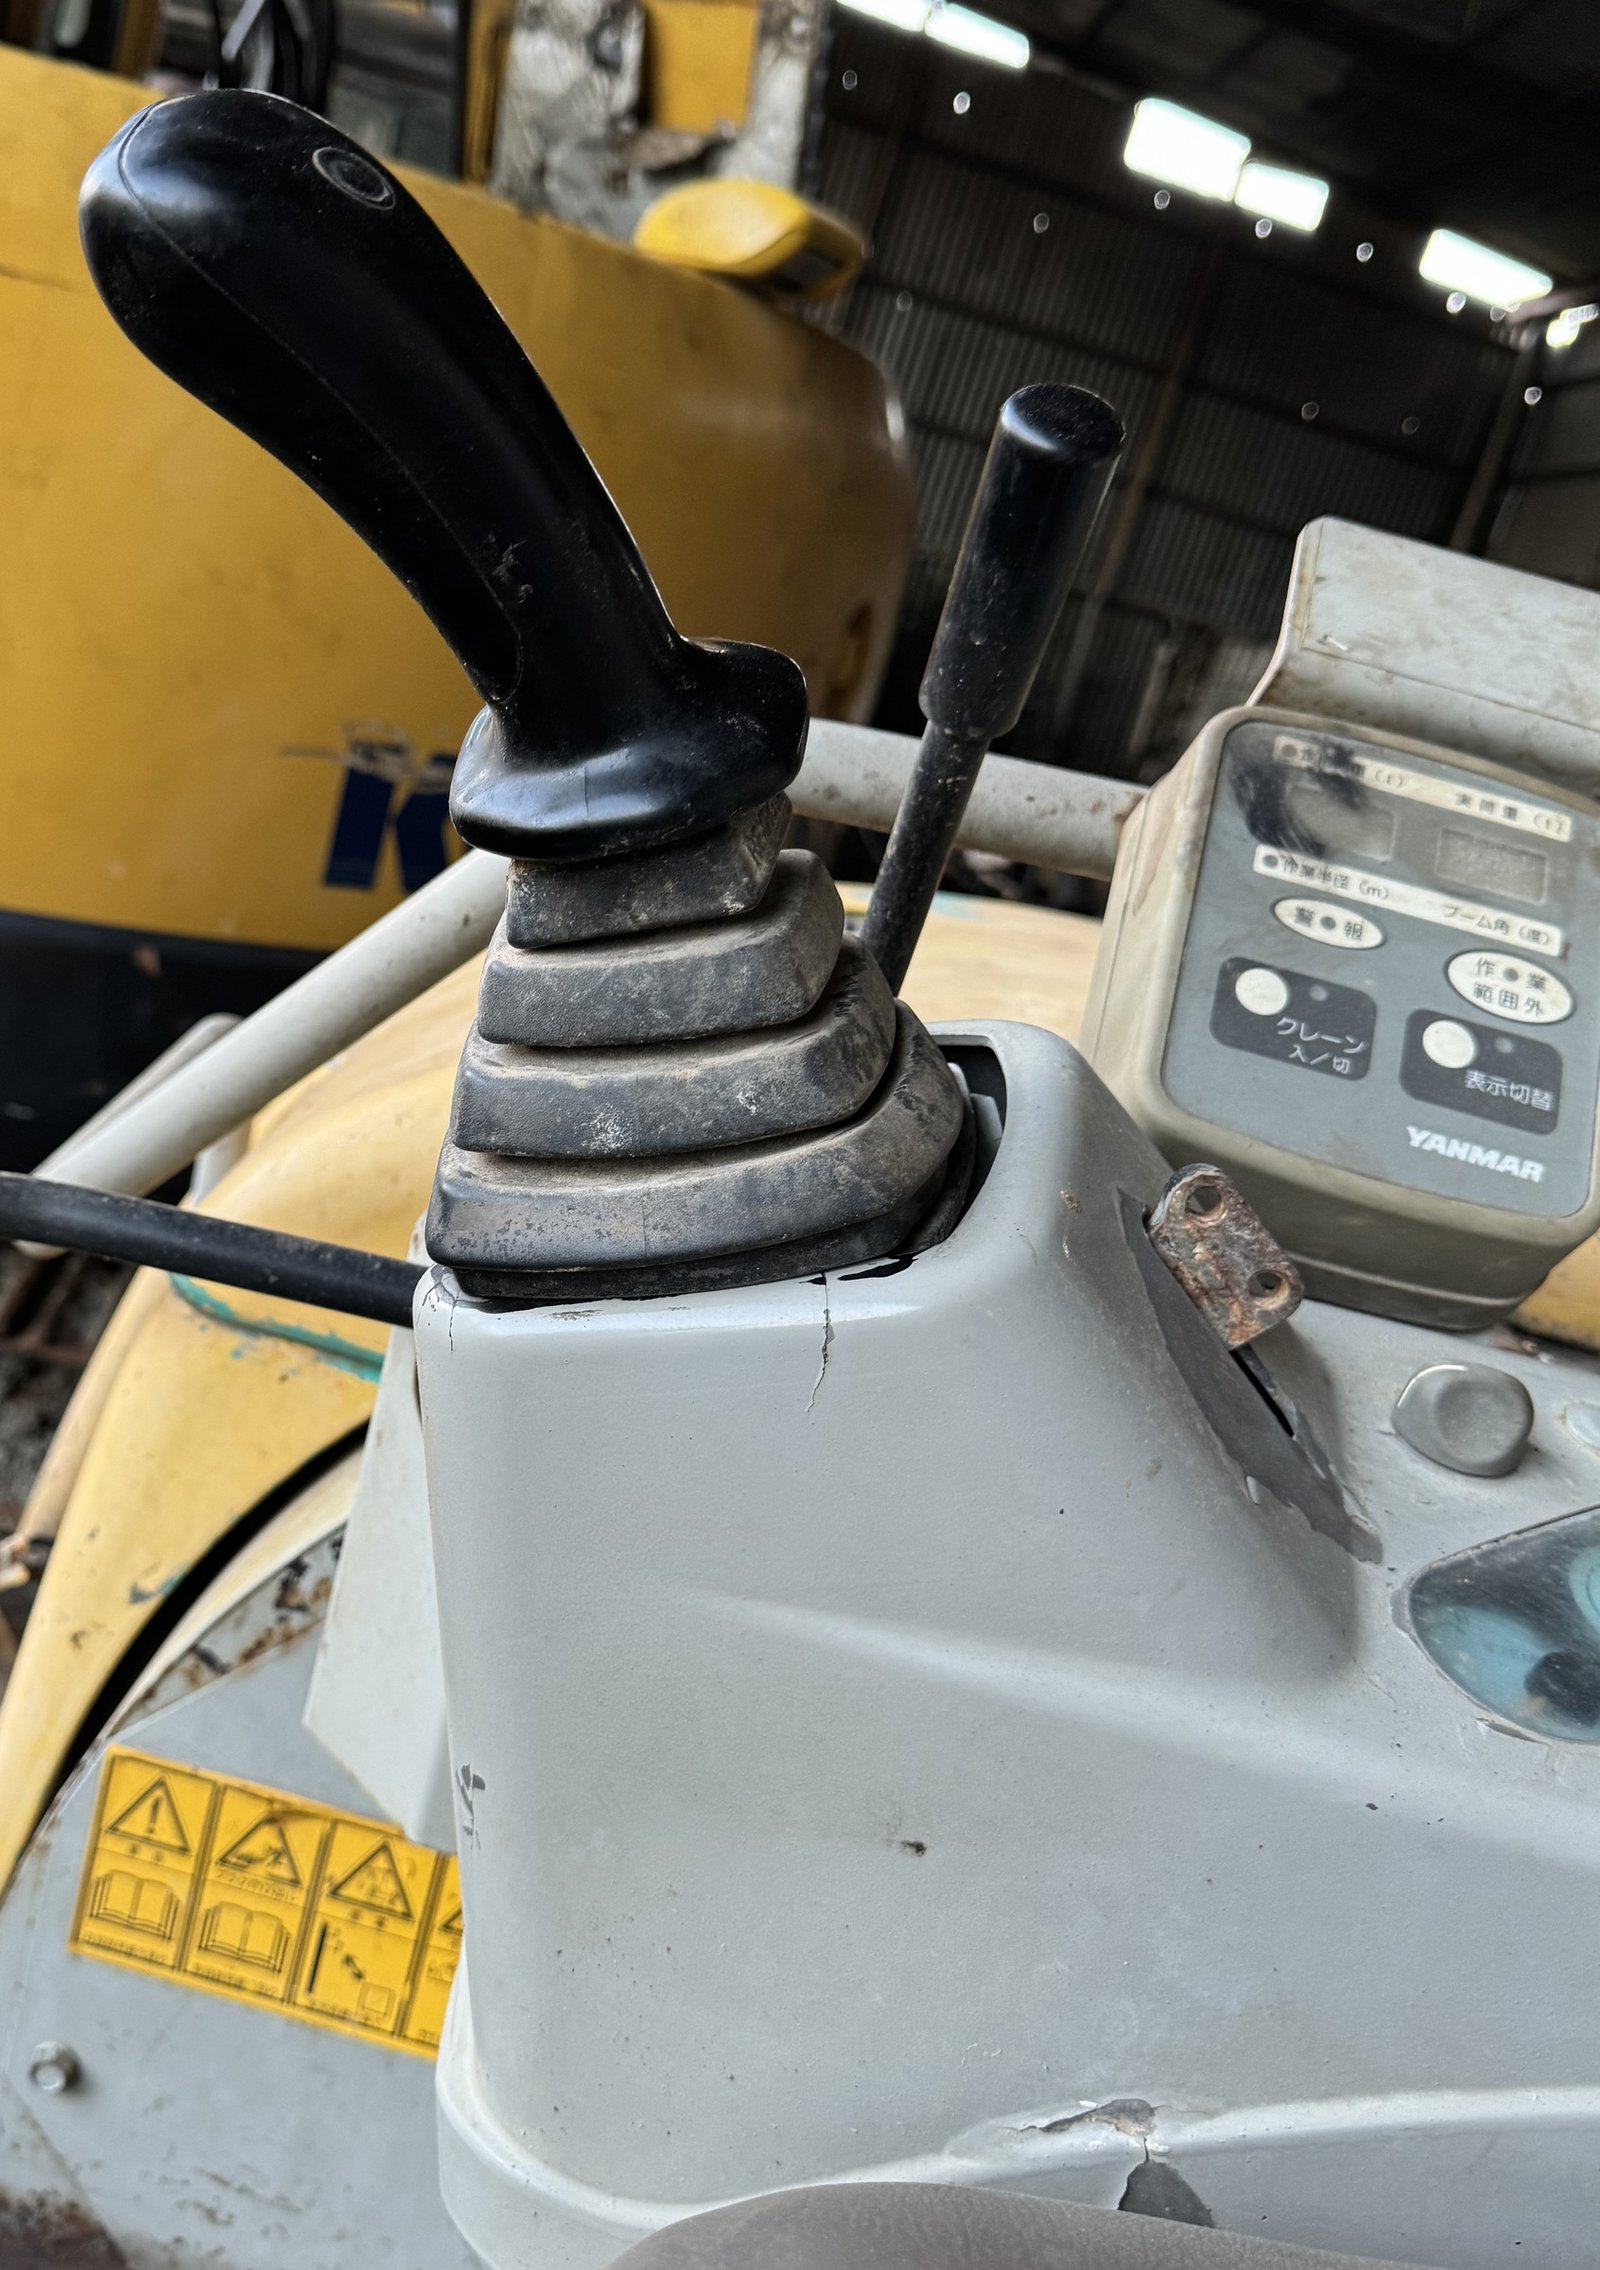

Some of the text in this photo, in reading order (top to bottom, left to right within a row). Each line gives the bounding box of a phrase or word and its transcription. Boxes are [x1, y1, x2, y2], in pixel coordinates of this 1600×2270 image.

[1473, 981, 1544, 1017] 範囲外
[1276, 1016, 1365, 1054] クレーン
[1464, 1069, 1553, 1112] 表示切替
[1406, 1125, 1545, 1183] YANMAR
